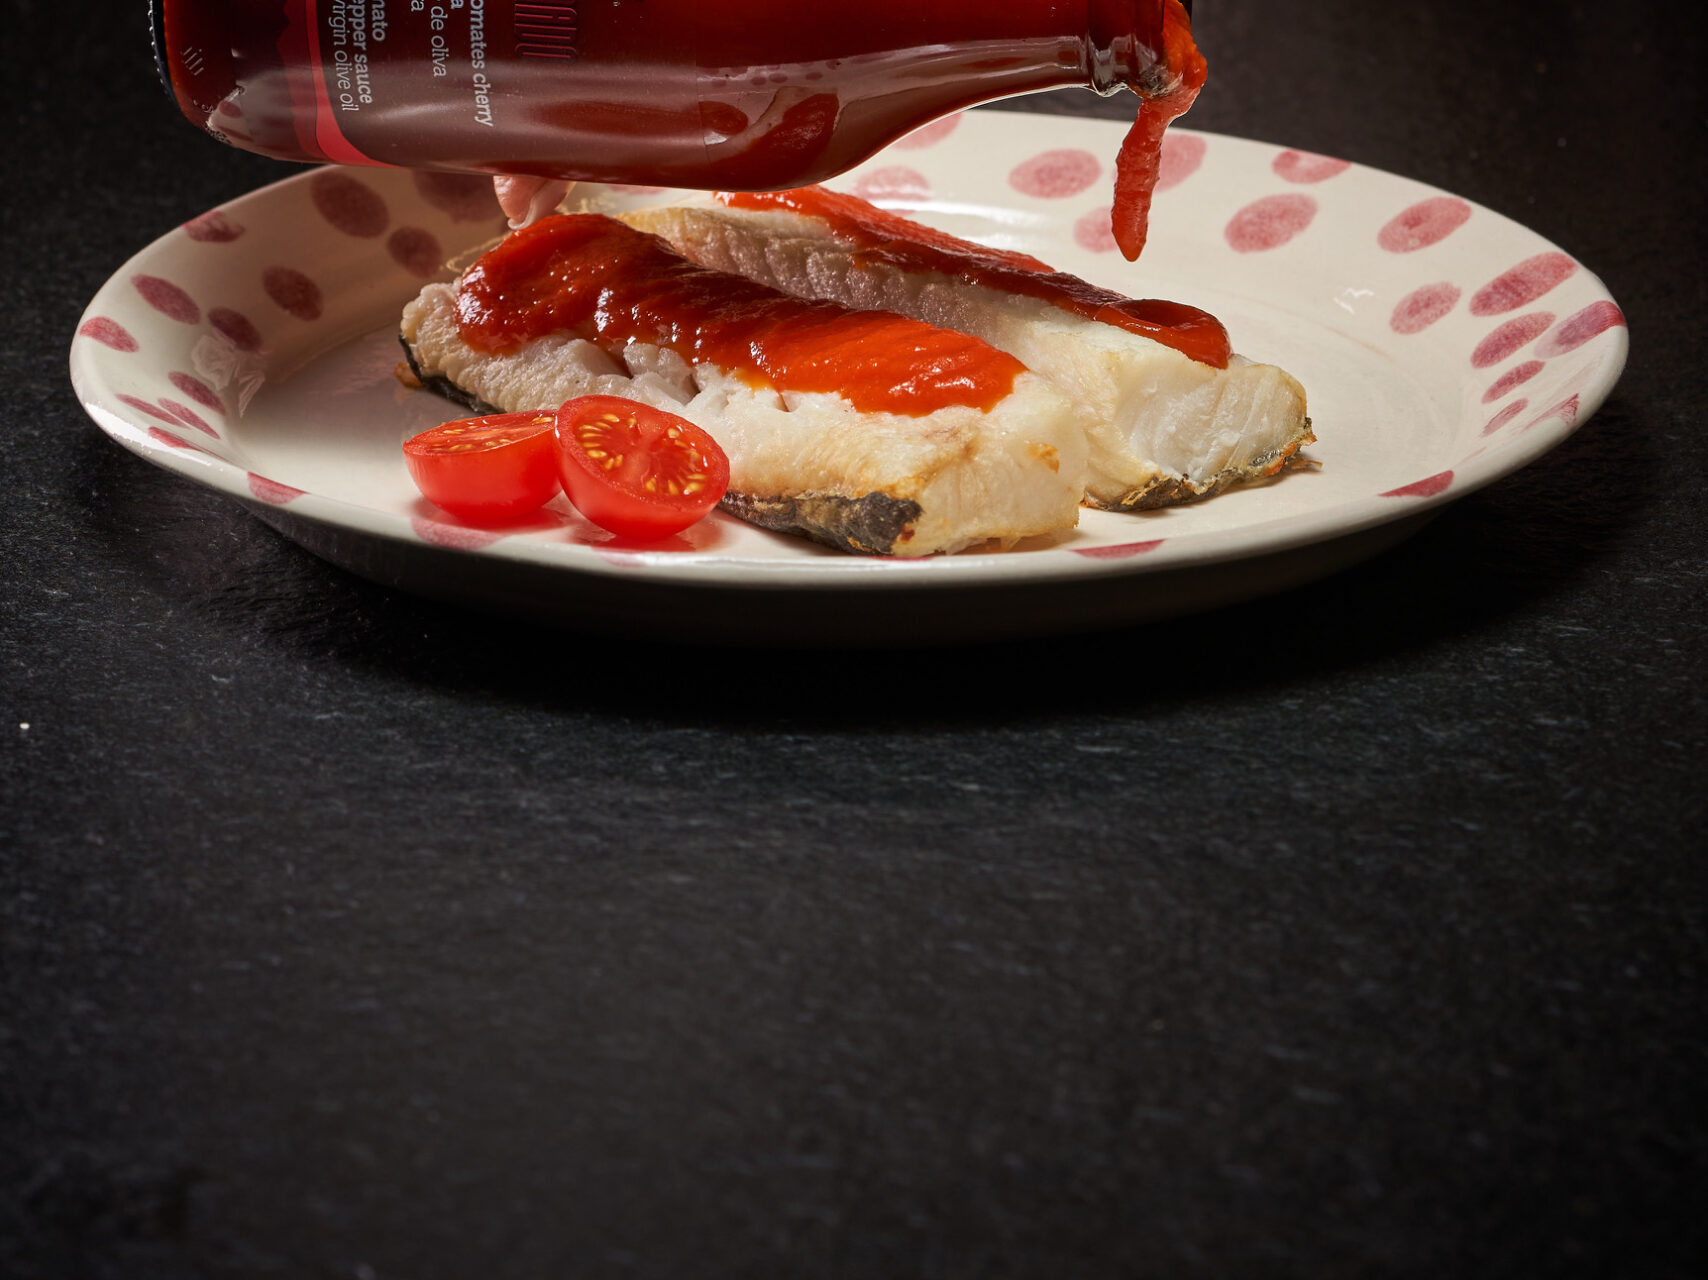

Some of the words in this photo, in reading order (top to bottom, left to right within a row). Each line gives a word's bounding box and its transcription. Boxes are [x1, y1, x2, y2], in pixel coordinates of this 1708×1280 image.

[430, 5, 449, 31] de
[334, 50, 353, 90] olive
[430, 35, 450, 78] oliva
[353, 54, 373, 105] sauce
[472, 72, 494, 127] cherry
[339, 93, 360, 111] oil
